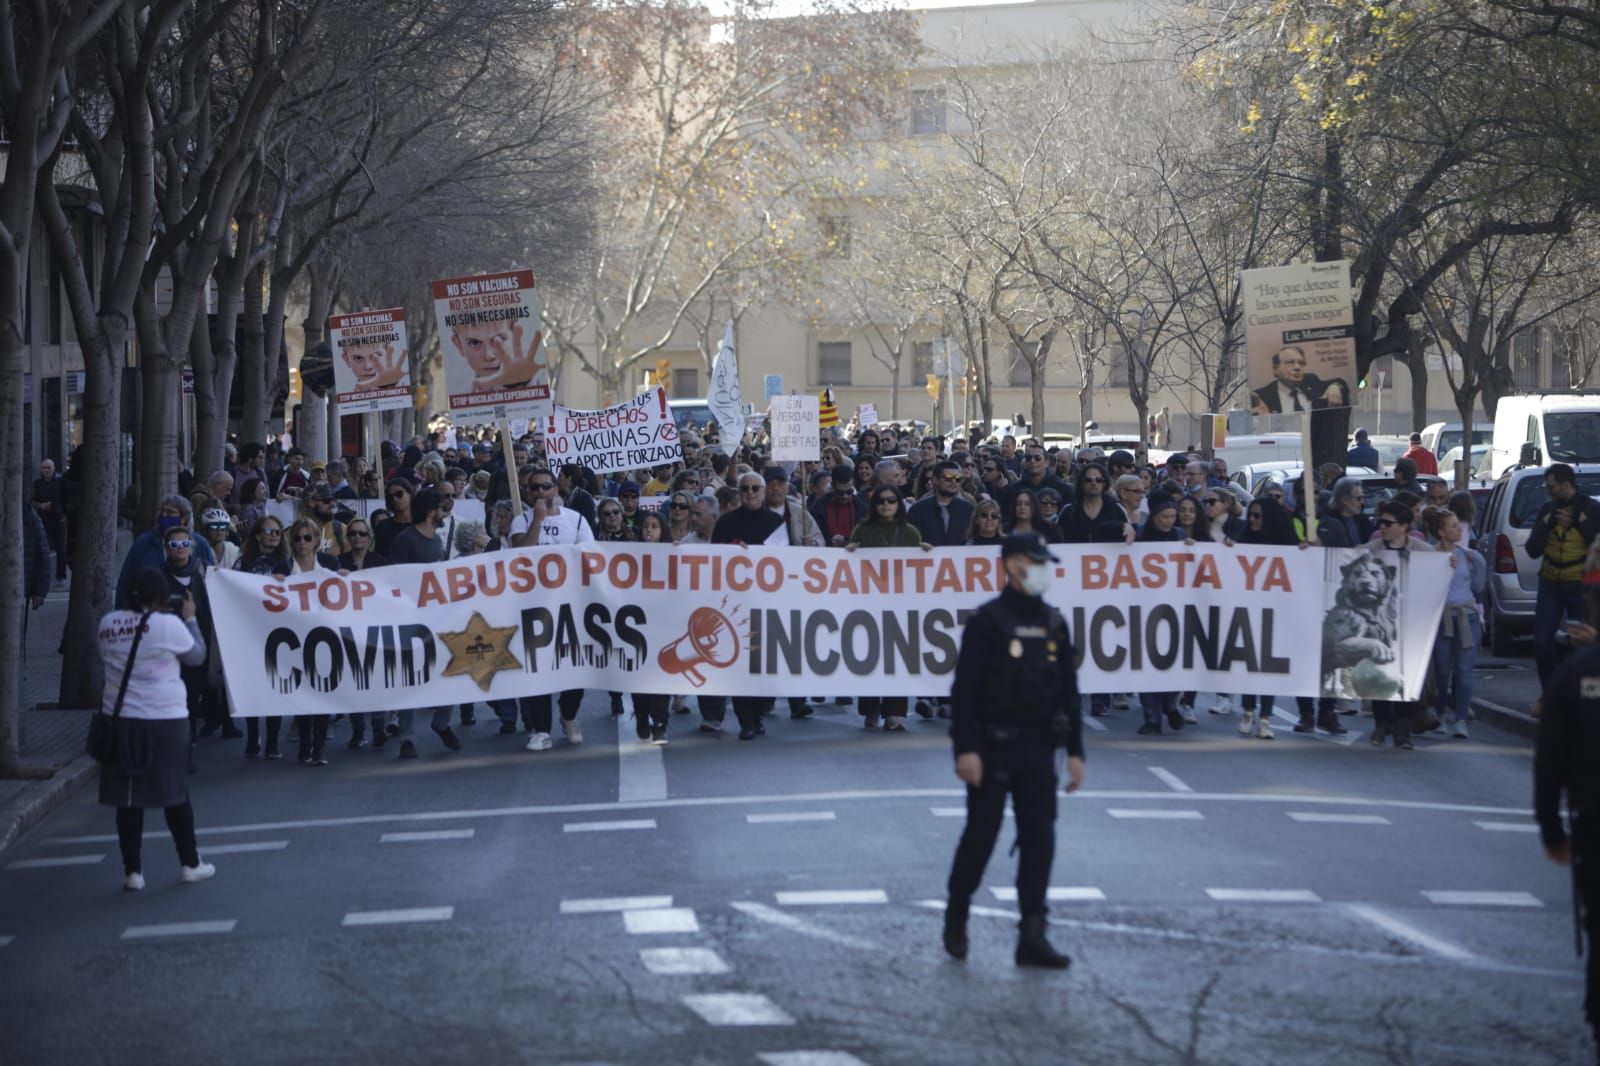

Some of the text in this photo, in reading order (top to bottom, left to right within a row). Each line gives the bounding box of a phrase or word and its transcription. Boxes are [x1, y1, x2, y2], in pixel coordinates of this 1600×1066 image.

[447, 276, 519, 297] NO SON VACUNAS
[449, 292, 521, 311] NO SON SEGURAS
[340, 313, 393, 327] NO SON VACUNAS
[445, 306, 530, 327] NO SON NECESARIAS
[341, 323, 394, 337] NO SON SEGURAS
[348, 337, 361, 347] SON
[361, 333, 400, 345] NECESARIAS
[786, 399, 802, 409] SIN
[565, 407, 649, 434] DERECHOS
[776, 411, 813, 422] VERDAD
[788, 423, 801, 434] NO
[546, 436, 569, 455] NO
[772, 436, 818, 448] LIBERTAD
[628, 443, 683, 466] FORZADO
[543, 526, 559, 536] YO
[262, 577, 376, 613] STOP
[417, 553, 567, 608] ABUSO
[581, 551, 1006, 594] POLITICO-SANITARI
[1081, 553, 1222, 590] BASTA
[1236, 554, 1292, 592] YA
[264, 602, 1290, 694] COVID PASS INCONSUCIONAL
